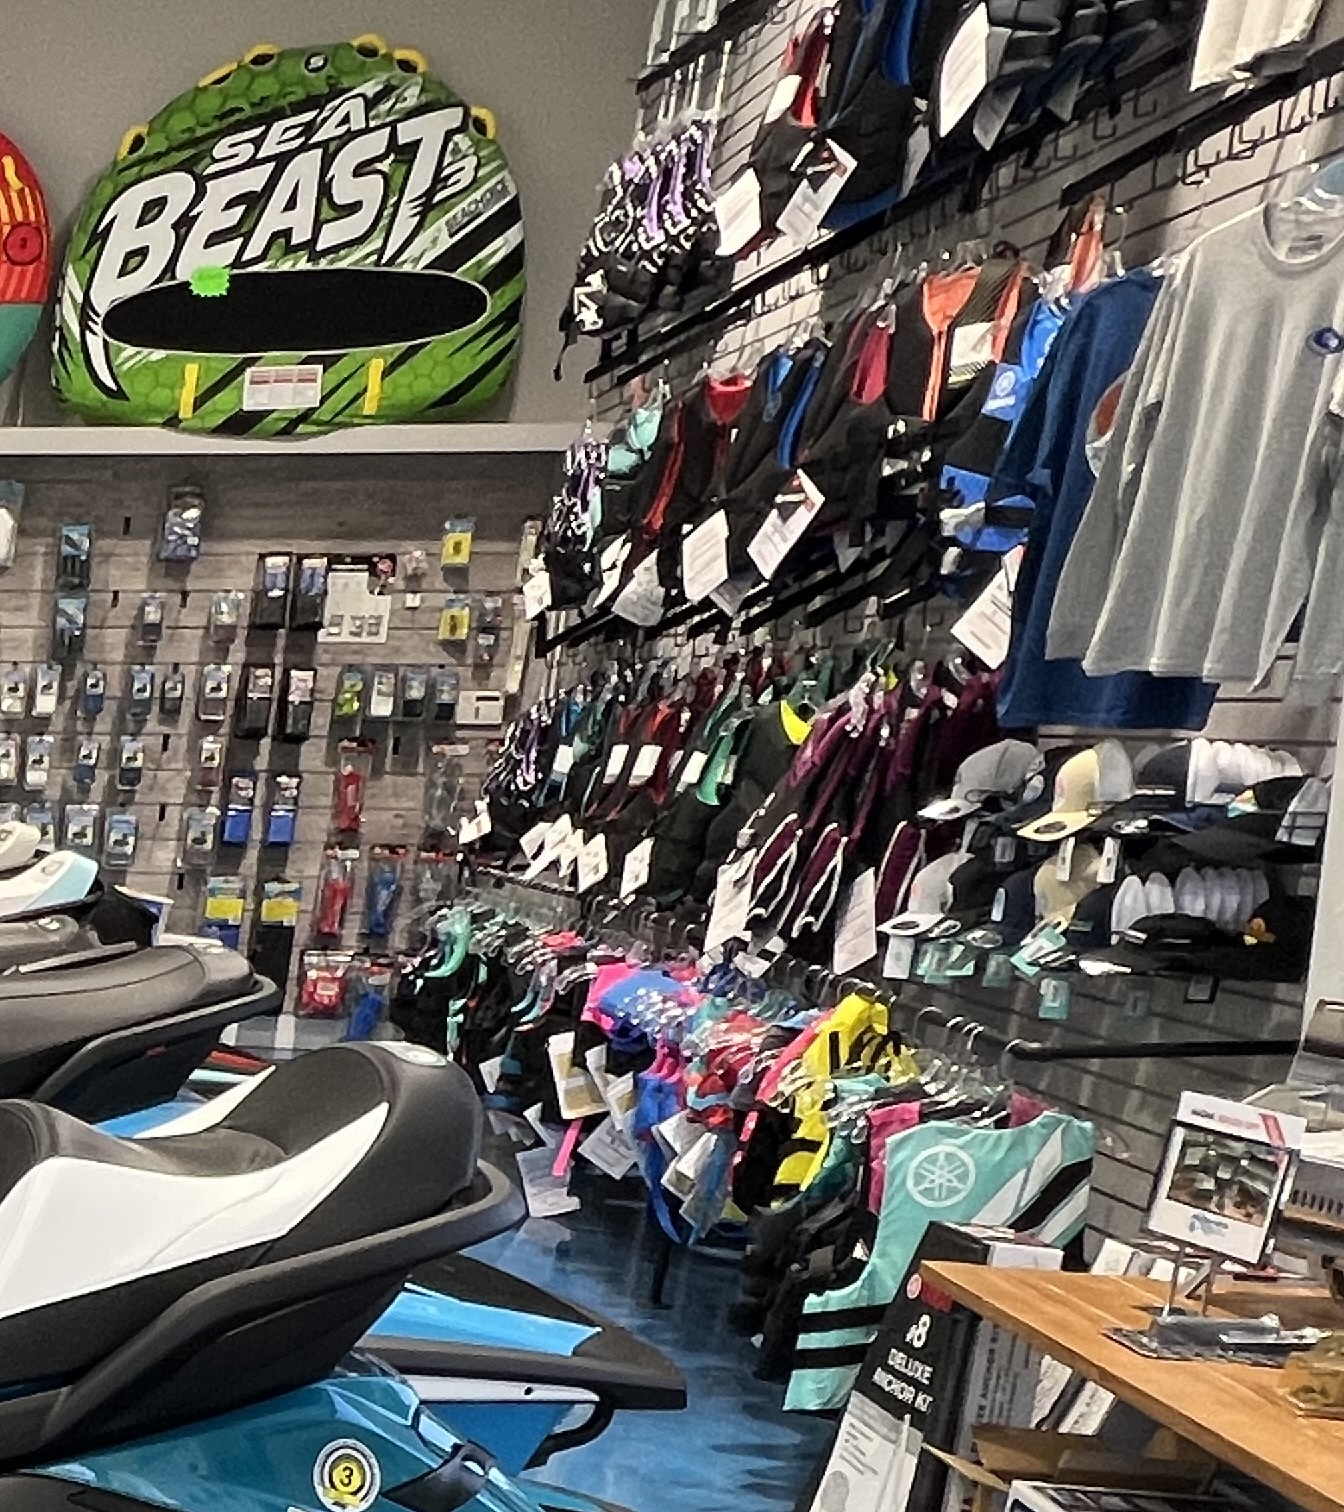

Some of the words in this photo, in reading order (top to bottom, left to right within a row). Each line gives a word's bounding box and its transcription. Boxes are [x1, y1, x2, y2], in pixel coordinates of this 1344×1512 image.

[209, 96, 372, 173] SEA
[88, 106, 466, 312] BEAST
[872, 1366, 916, 1405] ANCHOR
[887, 1347, 933, 1386] DELUXE
[338, 1465, 354, 1486] 3
